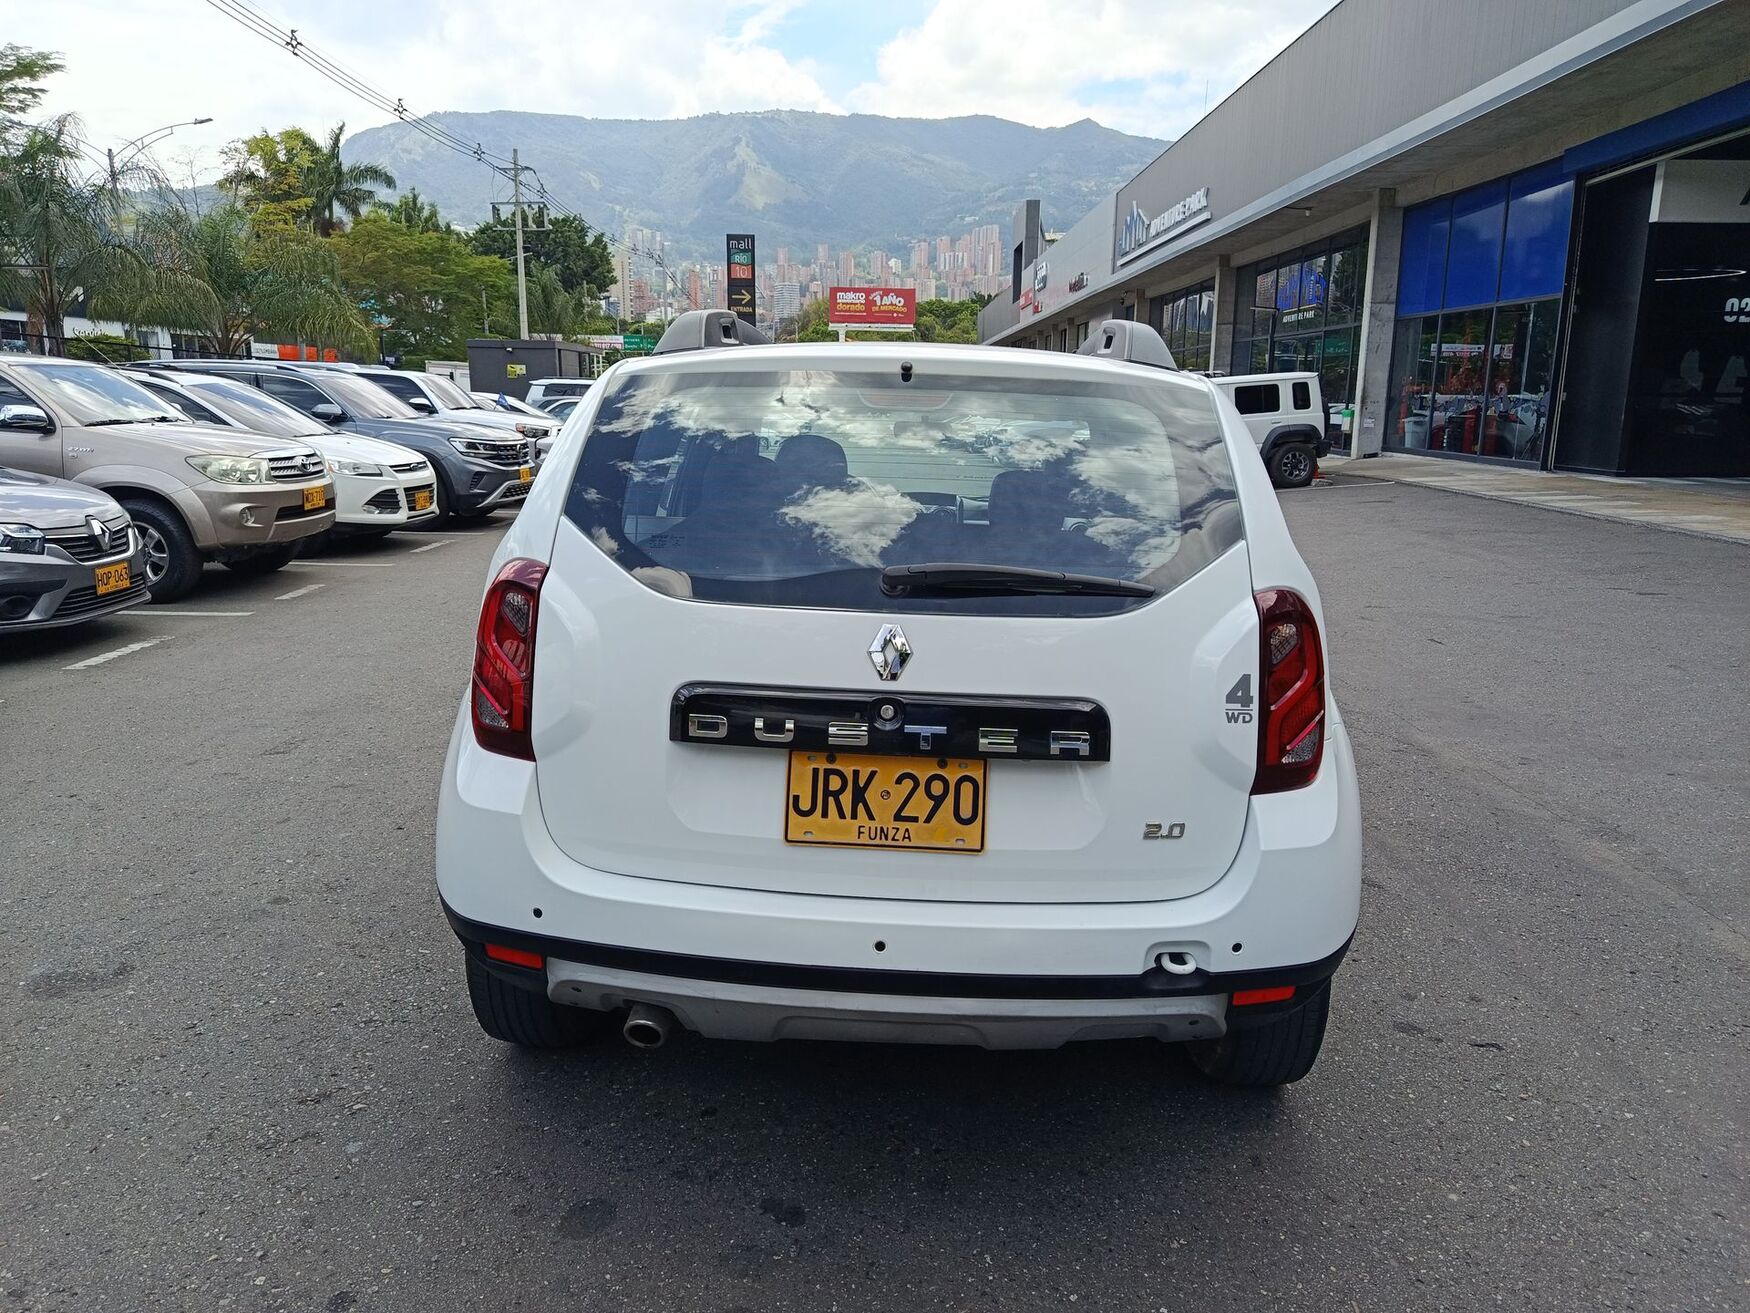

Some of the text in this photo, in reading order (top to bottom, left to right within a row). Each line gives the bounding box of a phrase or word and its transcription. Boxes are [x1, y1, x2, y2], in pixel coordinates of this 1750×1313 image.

[729, 237, 752, 249] mall
[836, 291, 866, 300] makro
[881, 292, 904, 307] AÑO
[836, 303, 866, 311] dorado
[880, 305, 908, 313] MERCADO
[114, 567, 129, 584] 063
[1225, 673, 1254, 709] 4
[1225, 711, 1253, 724] WD
[688, 713, 1091, 756] DUSTER
[792, 767, 980, 826] JRK 290
[857, 825, 912, 843] FUNZA
[1143, 823, 1186, 840] 2.0
